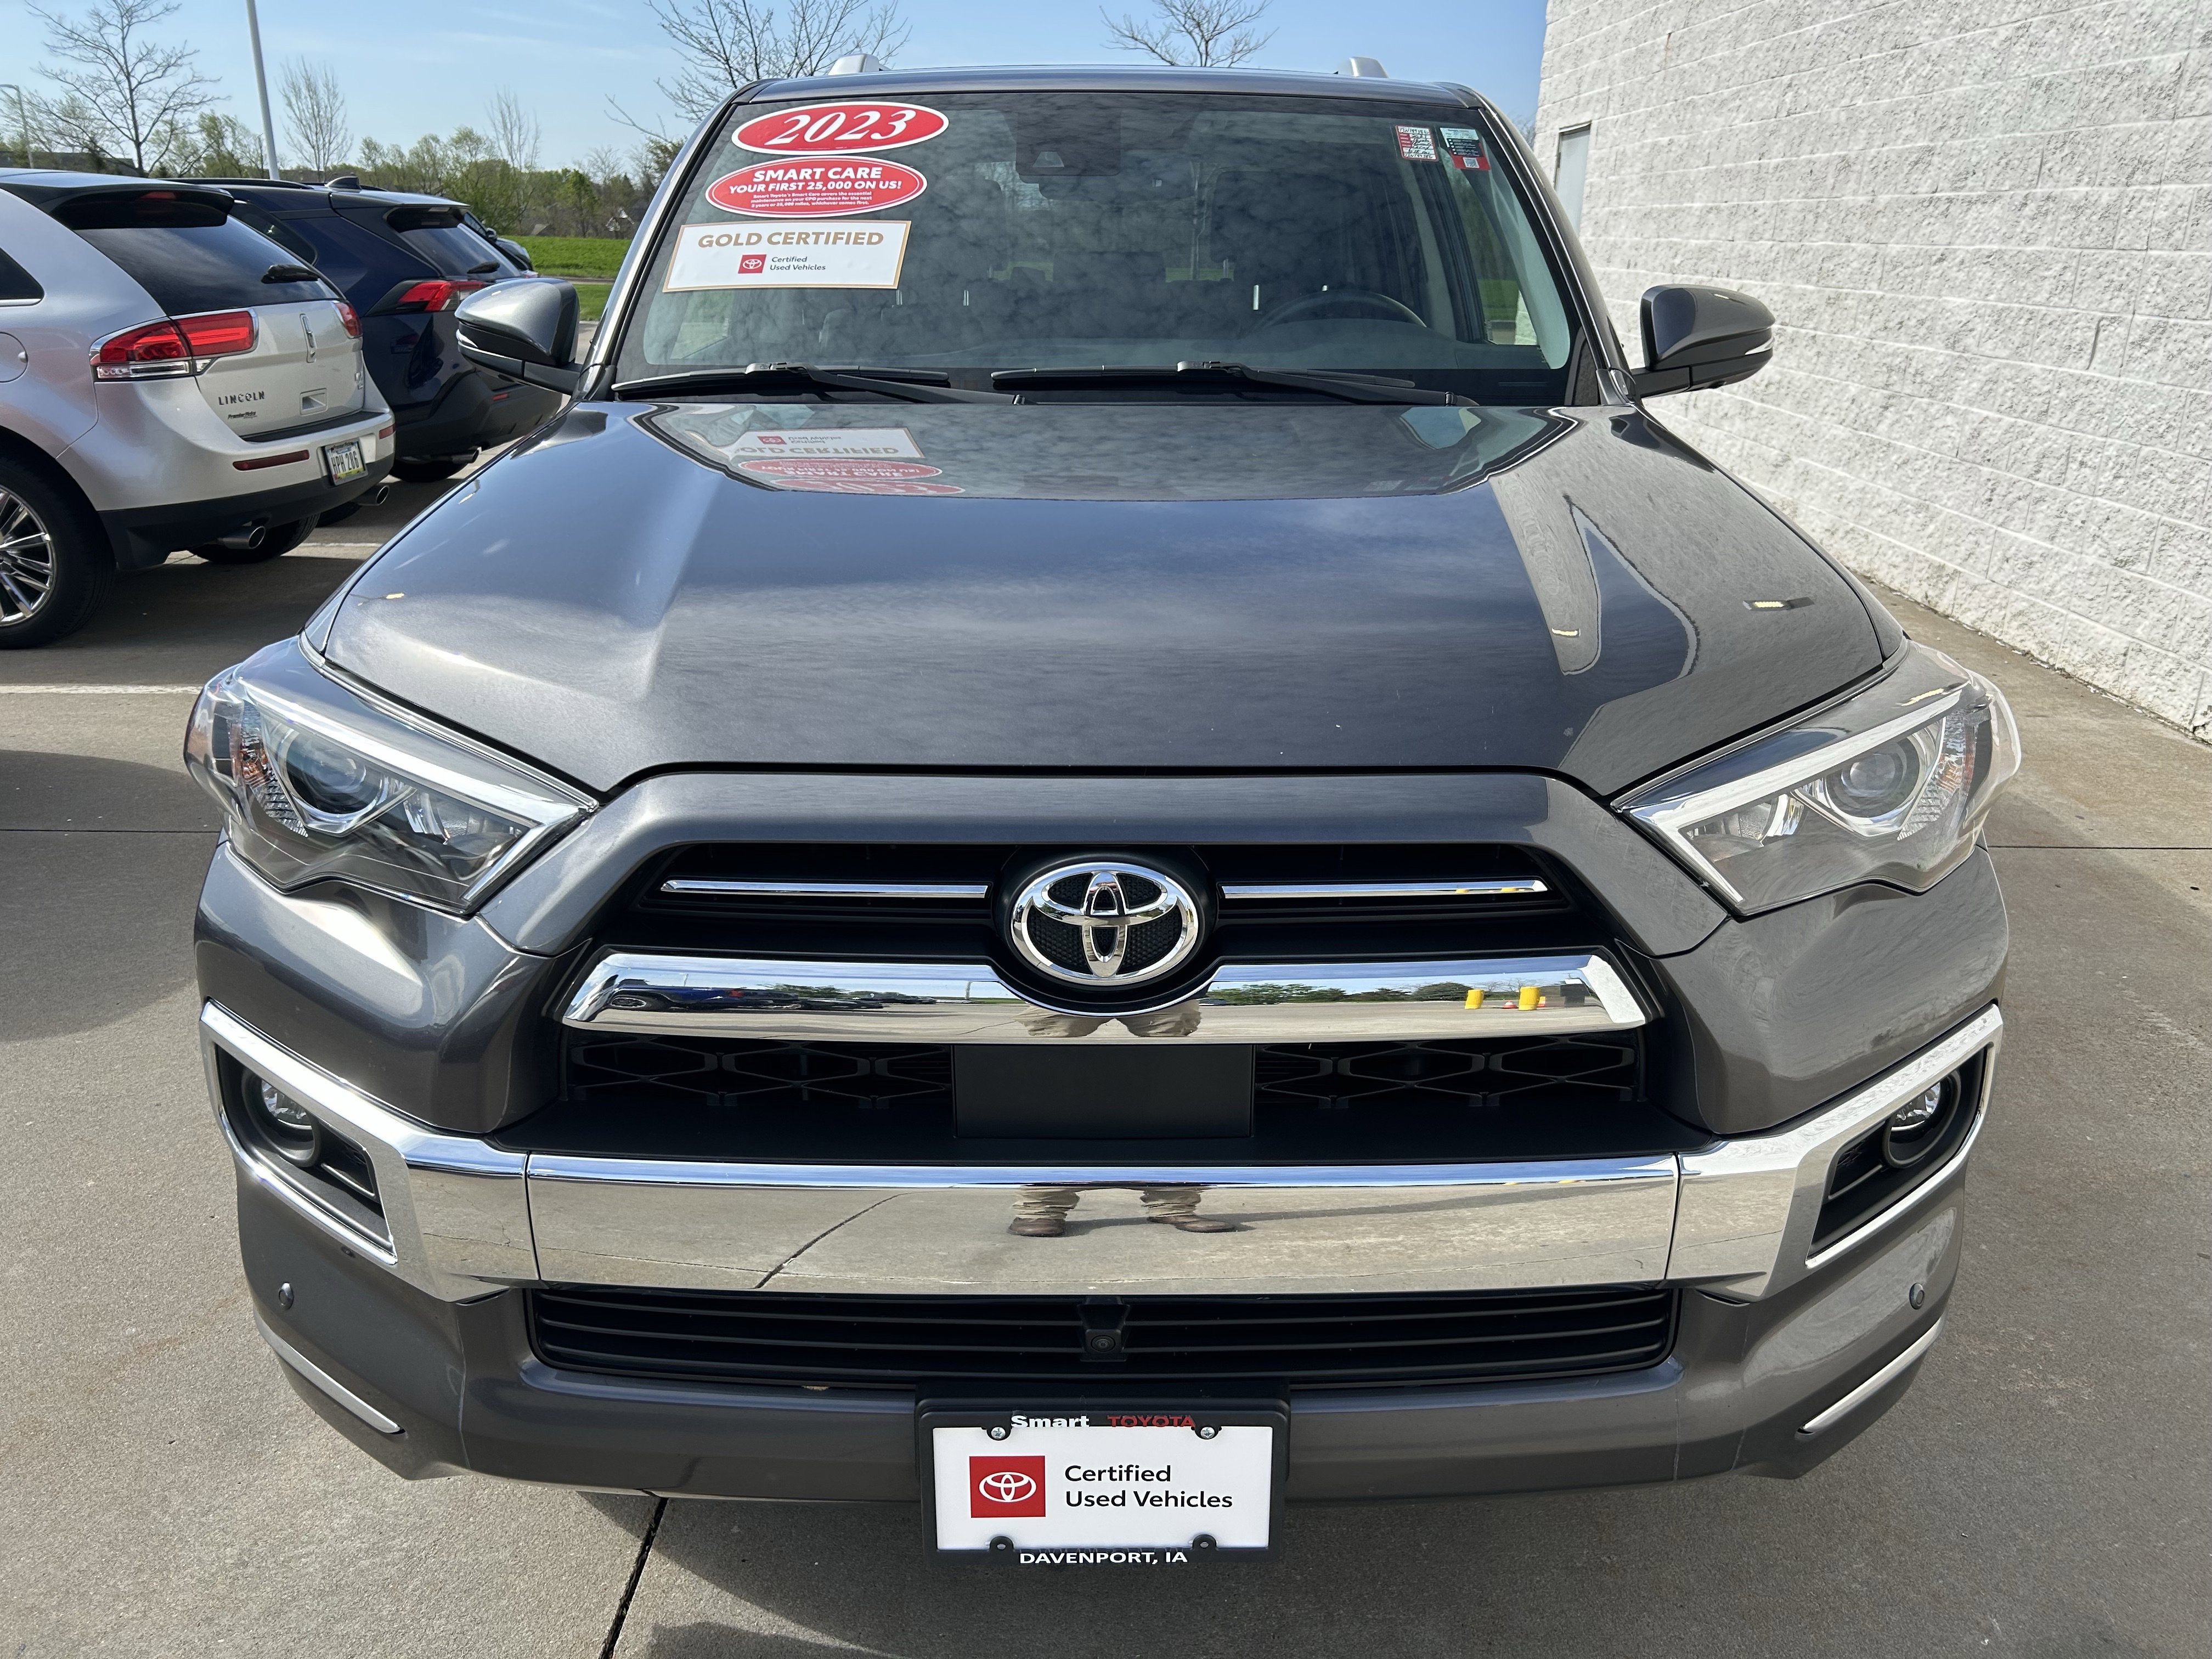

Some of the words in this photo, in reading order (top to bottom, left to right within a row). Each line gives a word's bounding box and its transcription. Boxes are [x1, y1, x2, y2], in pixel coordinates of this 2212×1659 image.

[764, 110, 917, 146] 2023
[752, 168, 826, 182] SMART
[827, 167, 883, 179] CARE
[729, 184, 766, 194] YOUR
[768, 182, 805, 191] FIRST
[806, 181, 852, 191] 25,000
[854, 180, 877, 189] ON
[879, 180, 902, 189] US!
[698, 233, 763, 248] GOLD
[767, 232, 884, 245] CERTIFIED
[218, 391, 265, 405] LINCOLN
[345, 451, 359, 470] 286
[1011, 1415, 1090, 1427] Smart
[1107, 1415, 1196, 1427] TOYOTA
[1064, 1465, 1171, 1482] Certified
[1065, 1491, 1126, 1508] Used
[1134, 1491, 1233, 1508] Vehicles
[1020, 1551, 1158, 1565] DAVENPORT,
[1165, 1551, 1188, 1563] IA
